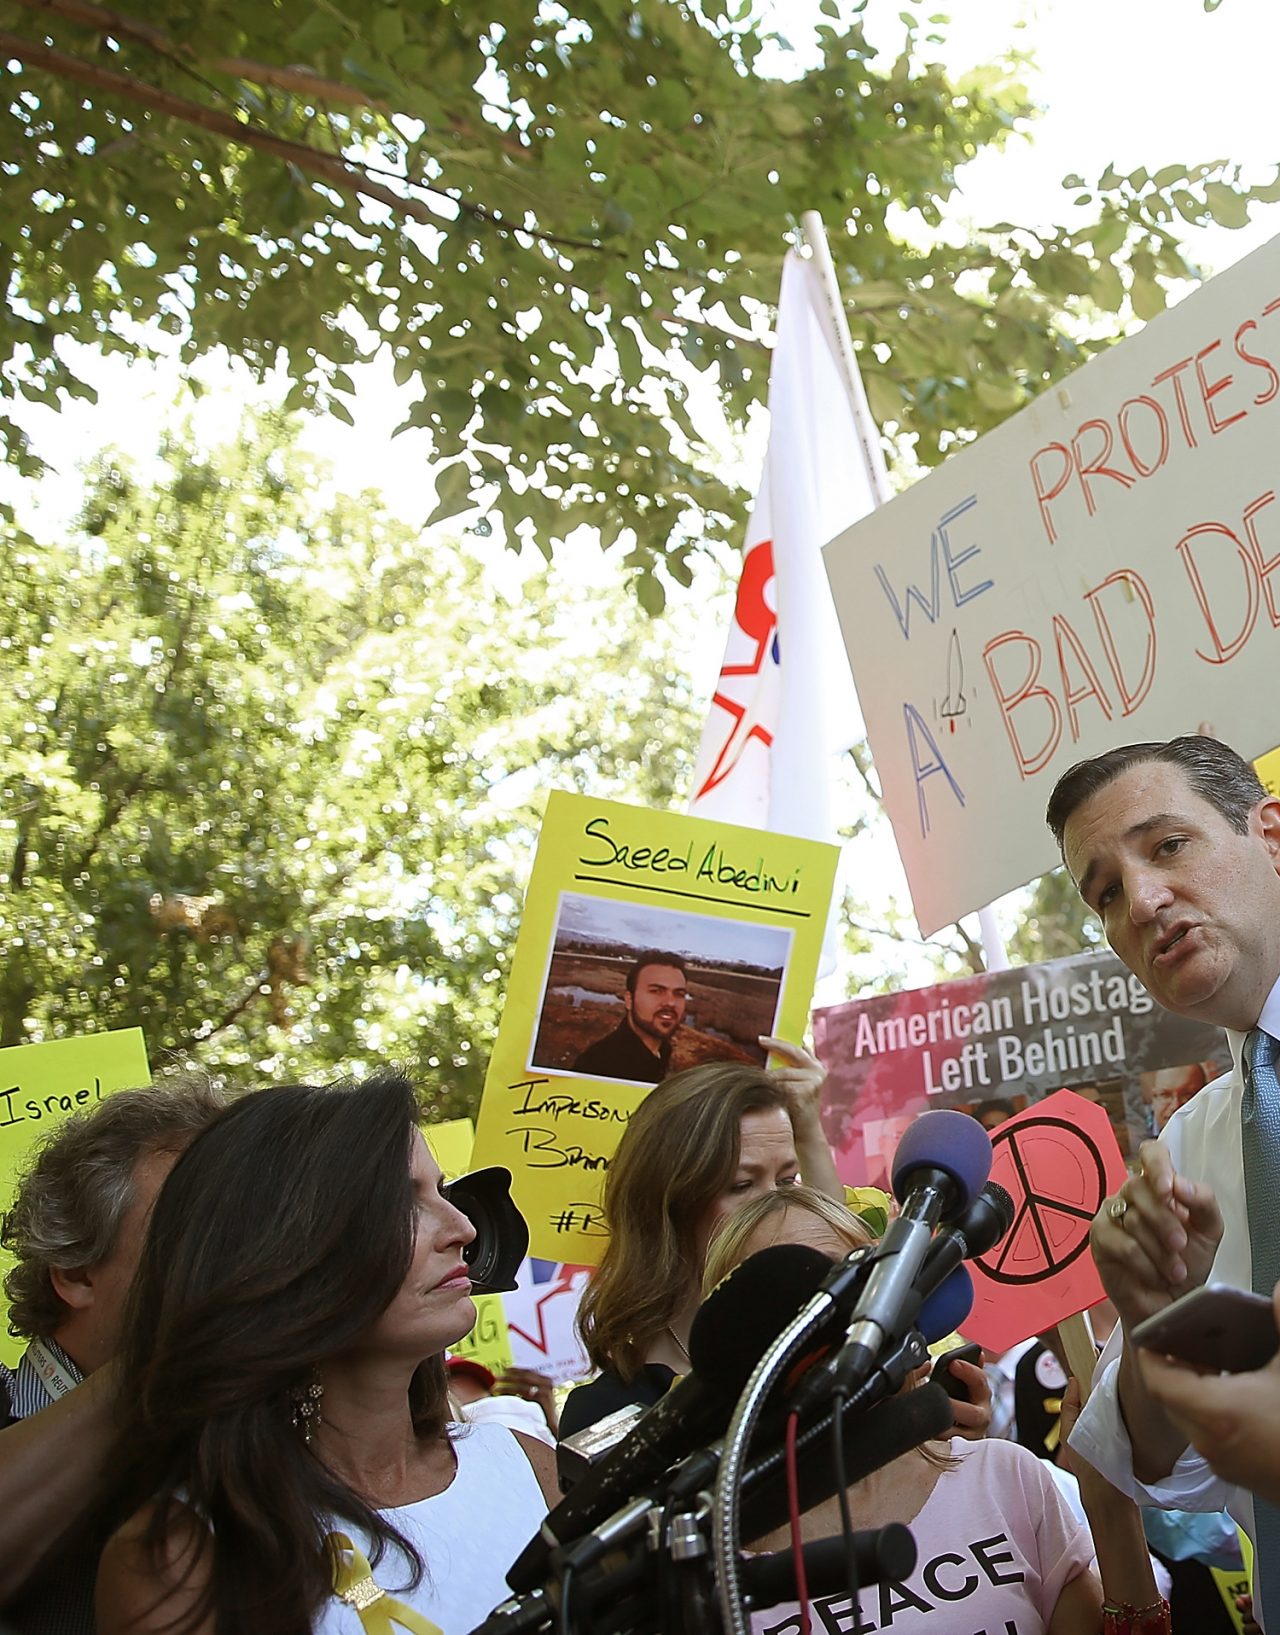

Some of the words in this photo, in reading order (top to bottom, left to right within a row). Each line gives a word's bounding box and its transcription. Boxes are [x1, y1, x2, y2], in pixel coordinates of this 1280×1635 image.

[875, 494, 994, 640] WE
[904, 702, 965, 838] A
[982, 568, 1156, 780] BAD
[578, 818, 694, 872] Saeed
[853, 990, 1014, 1058] American
[1020, 969, 1154, 1026] Hostag
[921, 1043, 991, 1097] Left
[999, 1015, 1127, 1083] Behind
[0, 1078, 102, 1127] Israel
